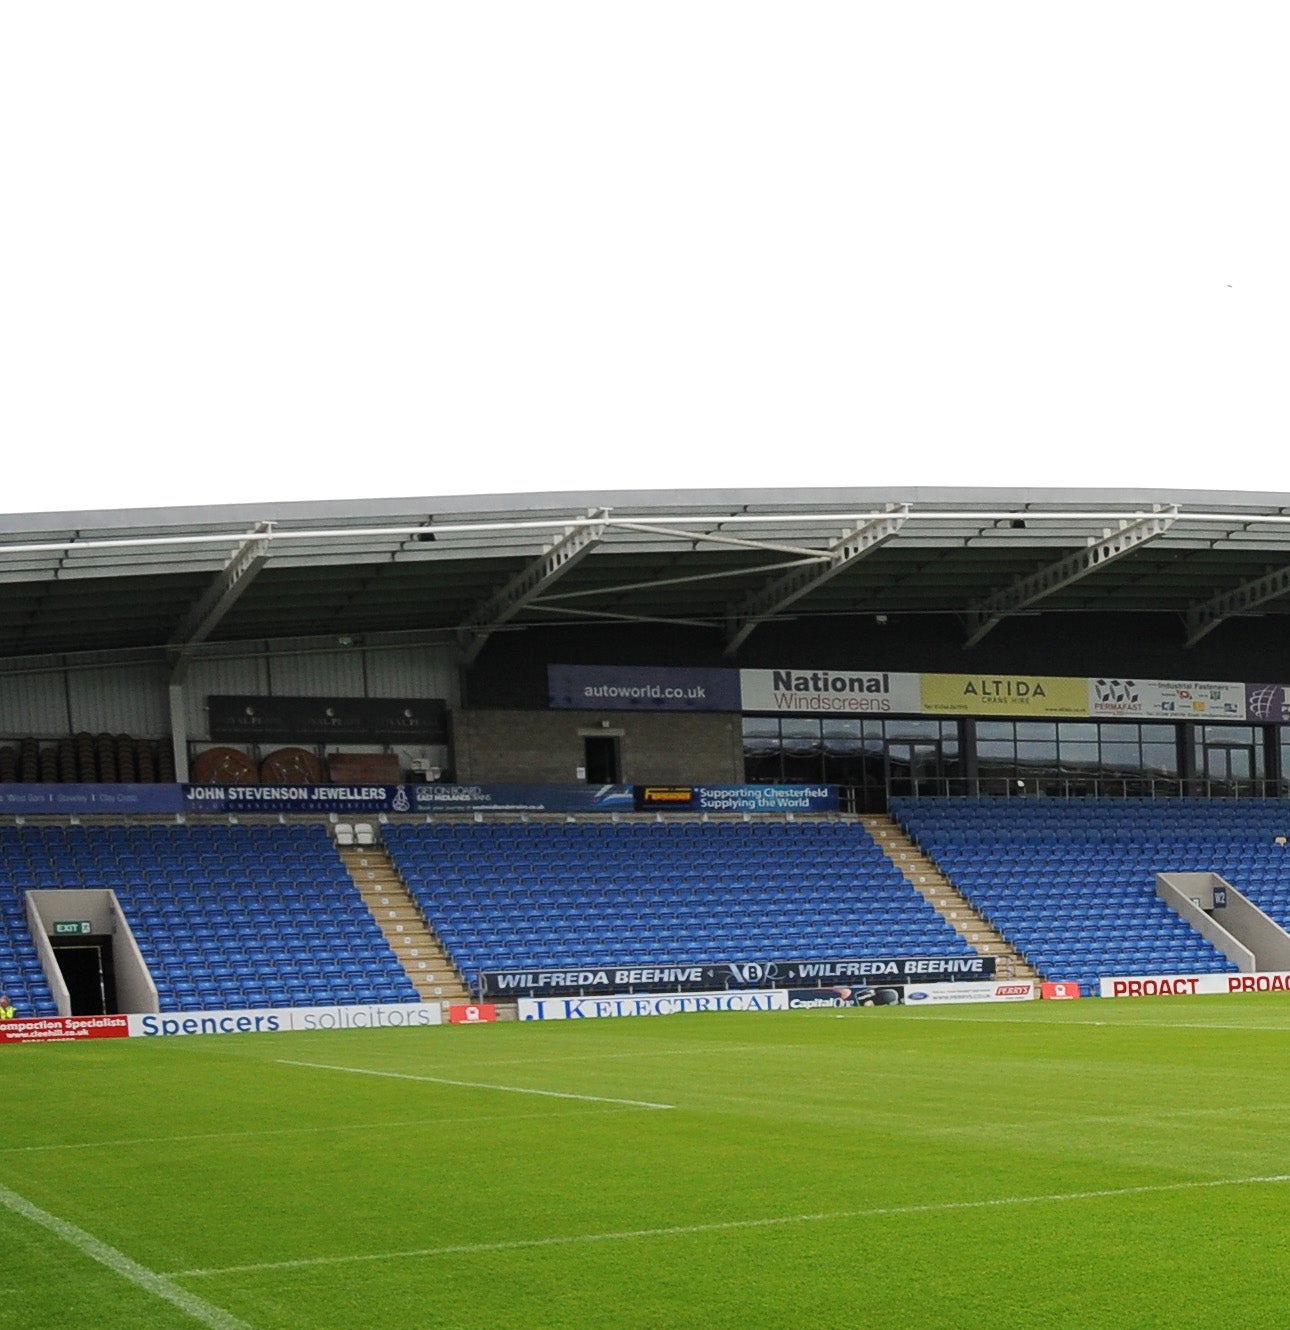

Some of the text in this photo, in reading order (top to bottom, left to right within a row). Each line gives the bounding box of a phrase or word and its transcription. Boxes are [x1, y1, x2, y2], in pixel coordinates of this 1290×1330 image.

[772, 671, 889, 694] National
[964, 680, 1046, 697] ALTIDA
[584, 684, 706, 698] autoworld.co.uk
[774, 693, 891, 712] Windscreens
[1095, 703, 1142, 711] PERMAFAST
[187, 787, 387, 800] JOHN STEVENSON JEWELLERS
[700, 788, 761, 799] Supporting
[763, 788, 828, 799] Chesterfield
[700, 798, 810, 809] Supplying the World
[1214, 891, 1226, 904] W2
[56, 923, 79, 933] EXIT
[798, 959, 983, 978] WILFREDA BEEHIVE
[498, 967, 703, 989] WILFREDA BEEHIVE
[997, 986, 1030, 996] PERRYS
[1113, 978, 1200, 997] PROACT
[565, 999, 589, 1019] K
[594, 994, 783, 1018] ELECTRICAL
[0, 1018, 127, 1032] ompaction Specialists
[142, 1004, 430, 1037] Spencers solicitors
